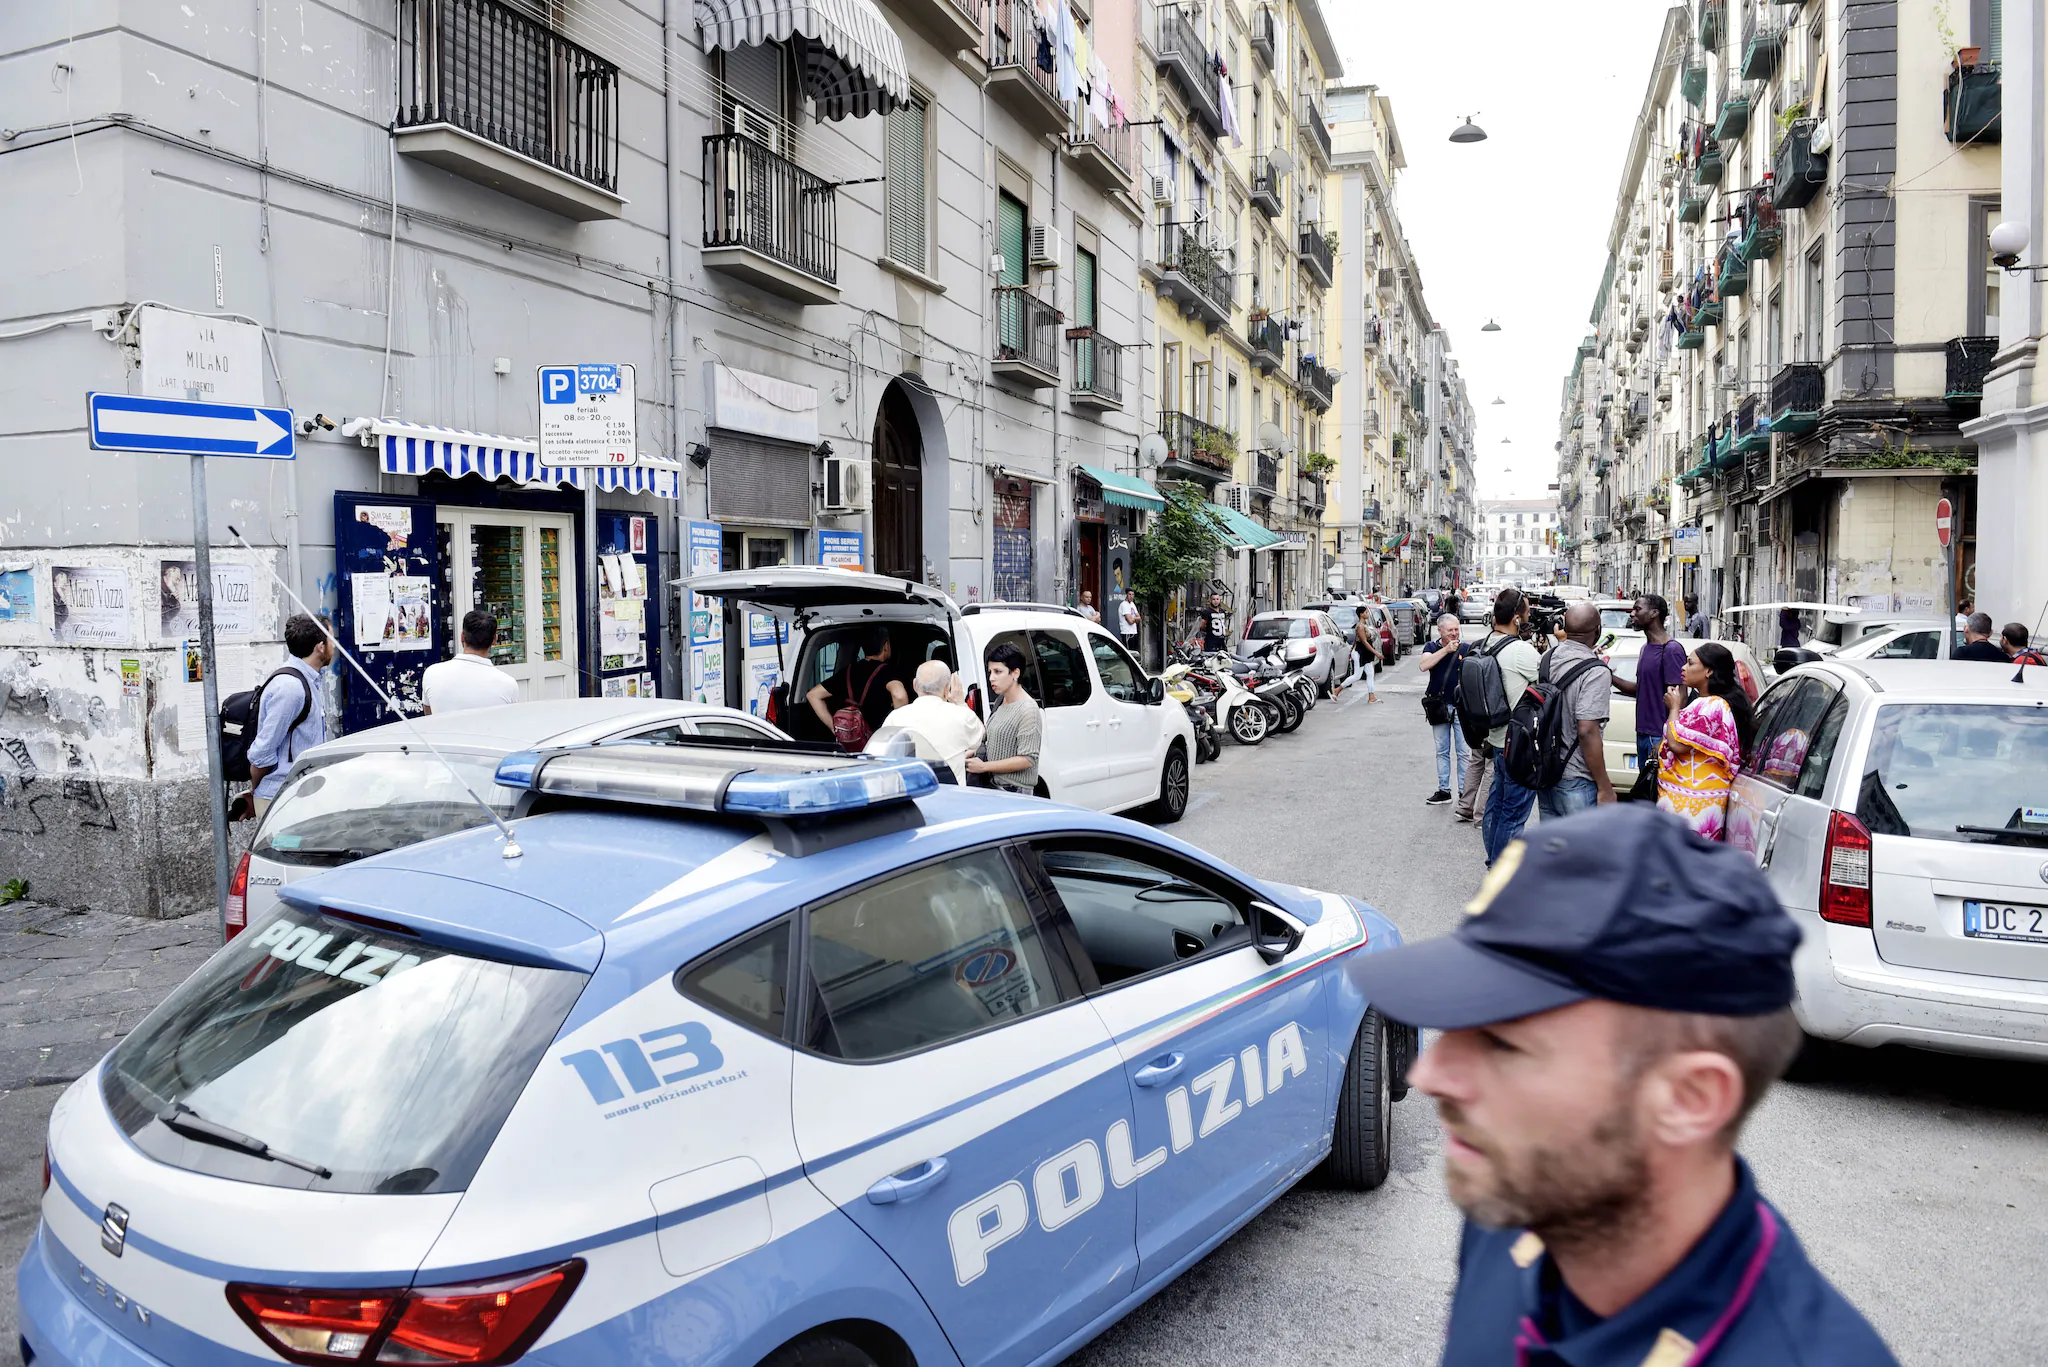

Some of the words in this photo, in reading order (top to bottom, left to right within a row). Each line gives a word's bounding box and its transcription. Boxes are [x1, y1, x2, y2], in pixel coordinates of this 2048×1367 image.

[186, 351, 229, 372] MILANO
[549, 373, 570, 401] P
[580, 374, 617, 390] 3704
[608, 453, 625, 462] 7D
[823, 537, 840, 545] PHONE
[840, 538, 860, 546] SERVICE
[1676, 530, 1683, 538] P
[69, 579, 95, 609] Mario
[96, 579, 124, 609] Vozza
[183, 573, 214, 602] Mao
[218, 574, 249, 602] Vozza
[72, 623, 117, 639] Castagna
[704, 651, 721, 672] Lyca
[752, 663, 765, 671] PHONE
[766, 662, 780, 670] SERVIC
[704, 669, 721, 682] mobile
[249, 874, 282, 888] picanto
[1985, 906, 2017, 932] DC
[2028, 909, 2043, 934] 2
[559, 1020, 725, 1106] 113
[947, 1021, 1308, 1287] POLIZIA
[78, 1263, 151, 1328] LEON
